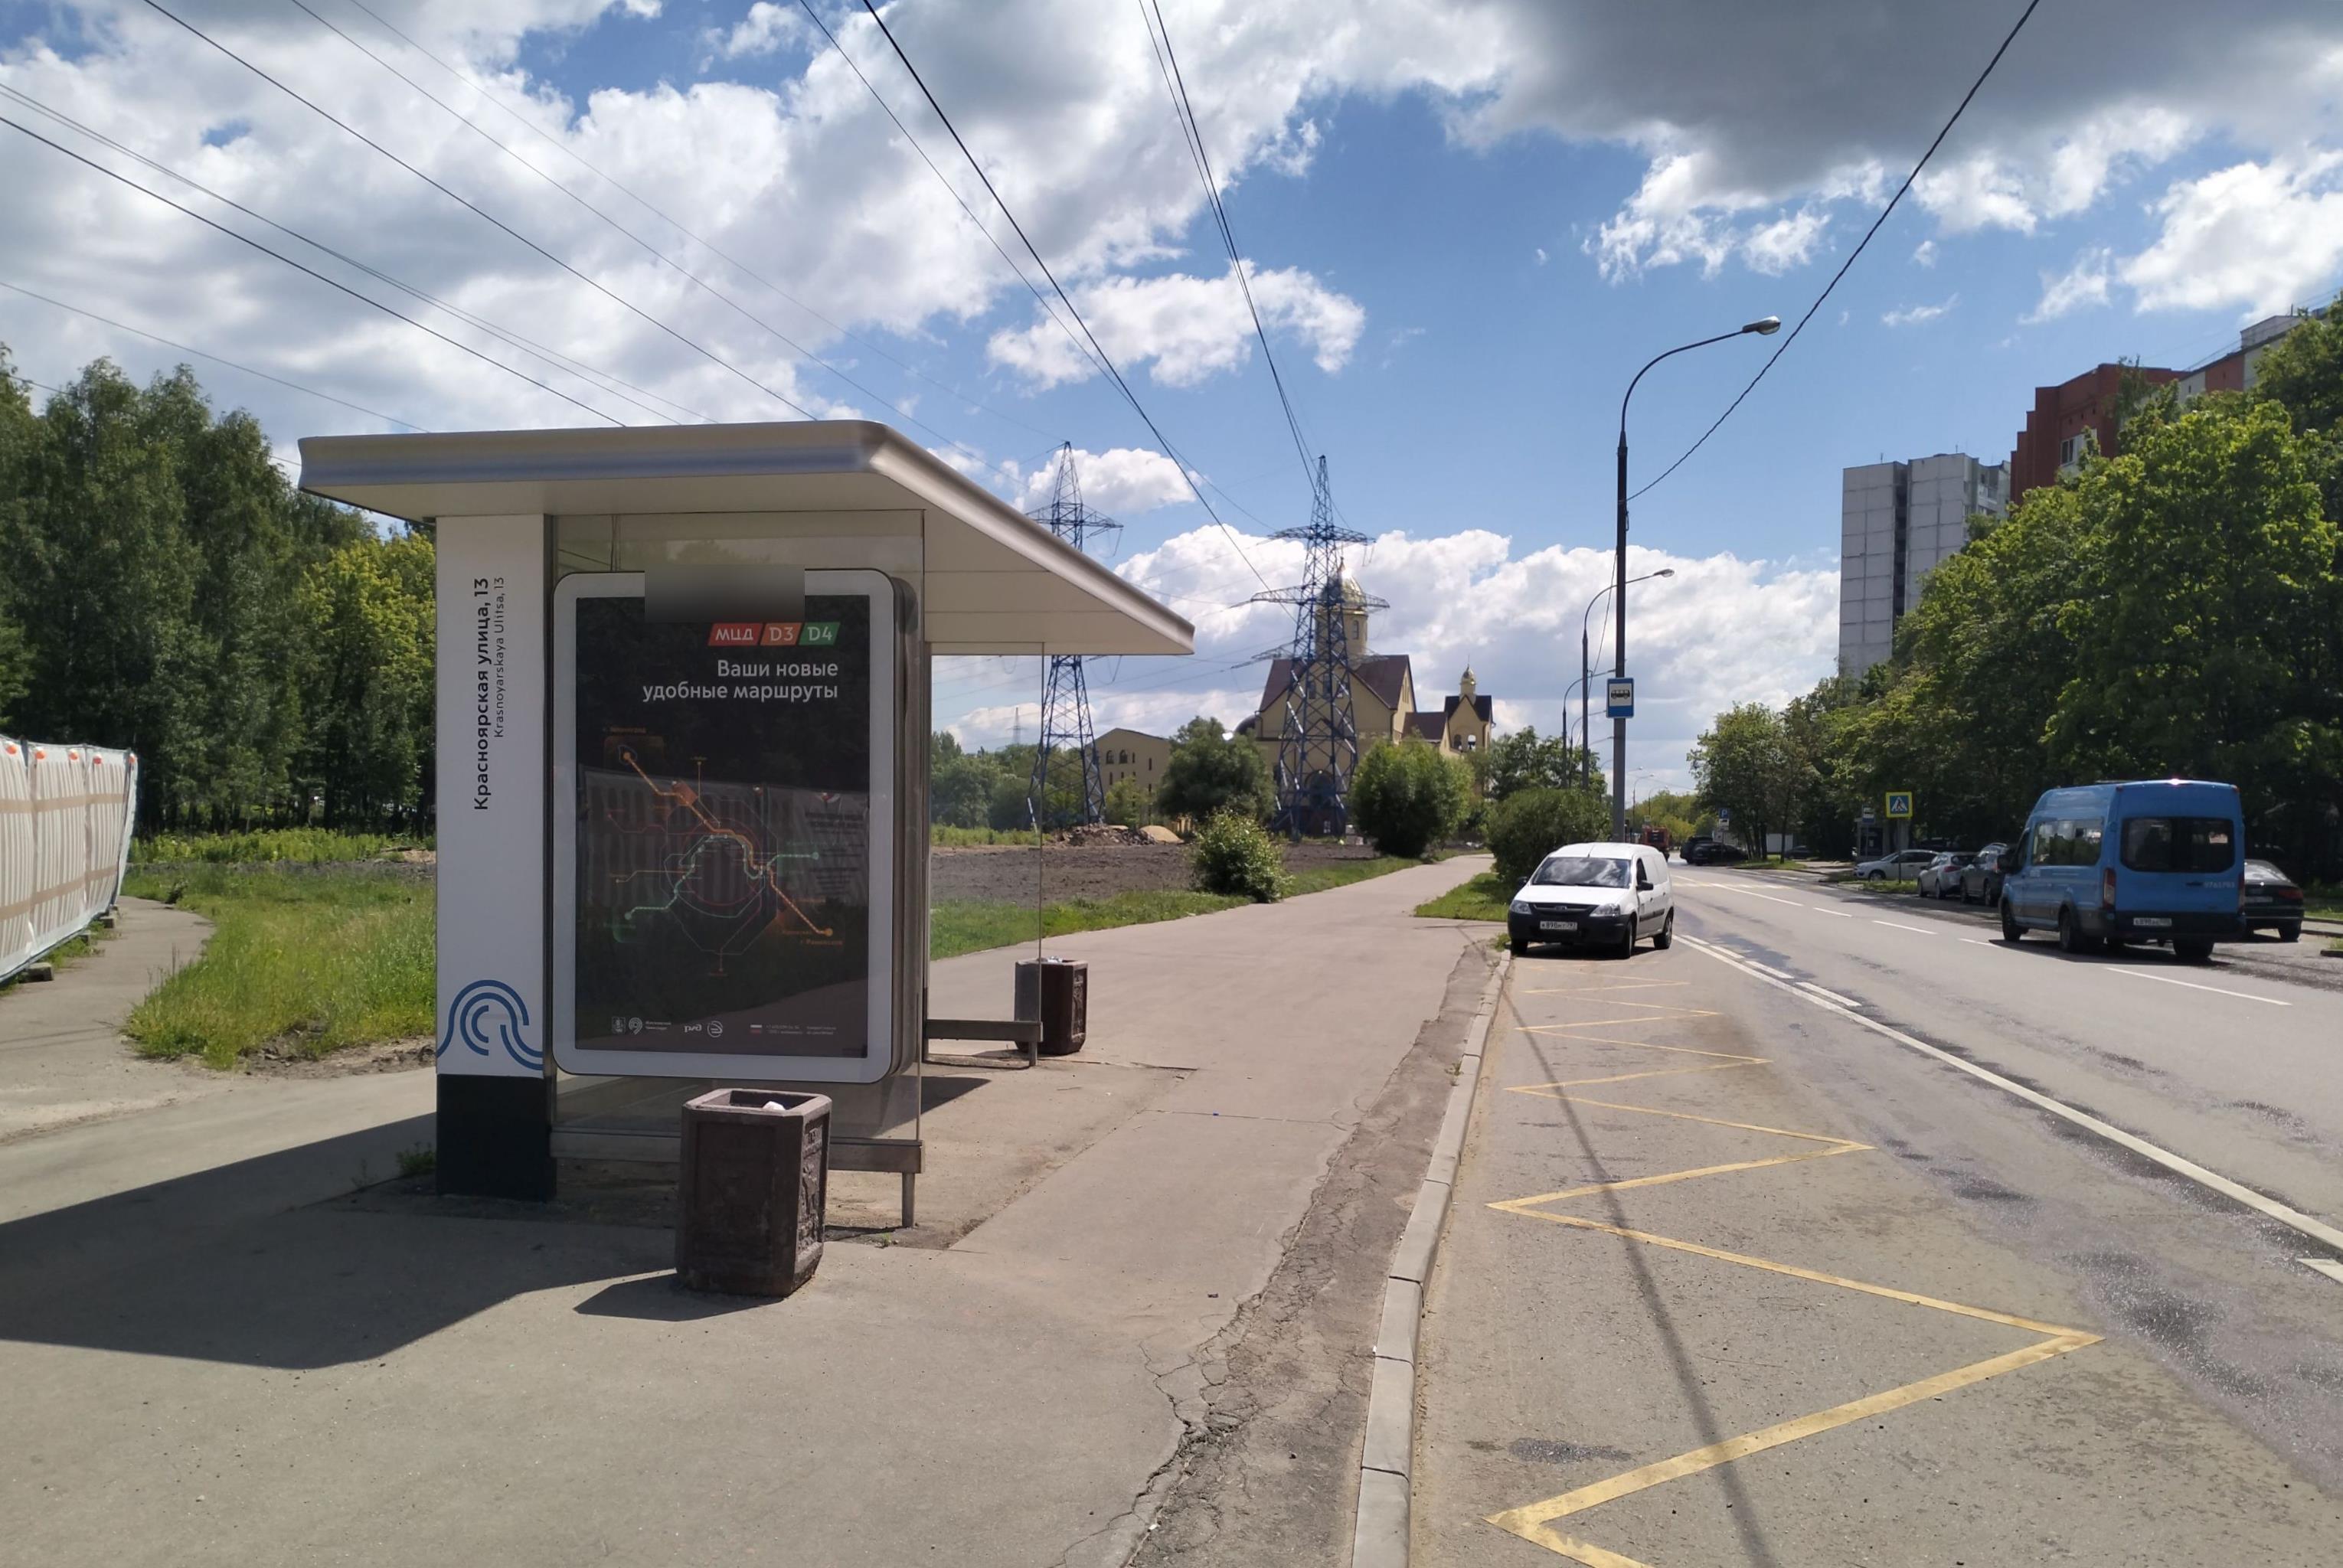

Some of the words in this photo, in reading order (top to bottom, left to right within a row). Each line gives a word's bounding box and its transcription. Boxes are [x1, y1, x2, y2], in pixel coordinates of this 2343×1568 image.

[474, 578, 489, 597] 13
[493, 577, 505, 590] 13
[493, 593, 506, 634] Ulitsa,
[478, 602, 492, 665] улица,
[715, 628, 753, 642] МЦД
[769, 627, 794, 641] D3
[807, 626, 834, 641] D4
[717, 659, 770, 677] Ваши
[776, 663, 838, 677] новые
[493, 637, 506, 738] Krasnoyarskaya
[642, 681, 728, 703] удобные
[734, 685, 838, 703] маршруты
[474, 671, 492, 810] Красноярская
